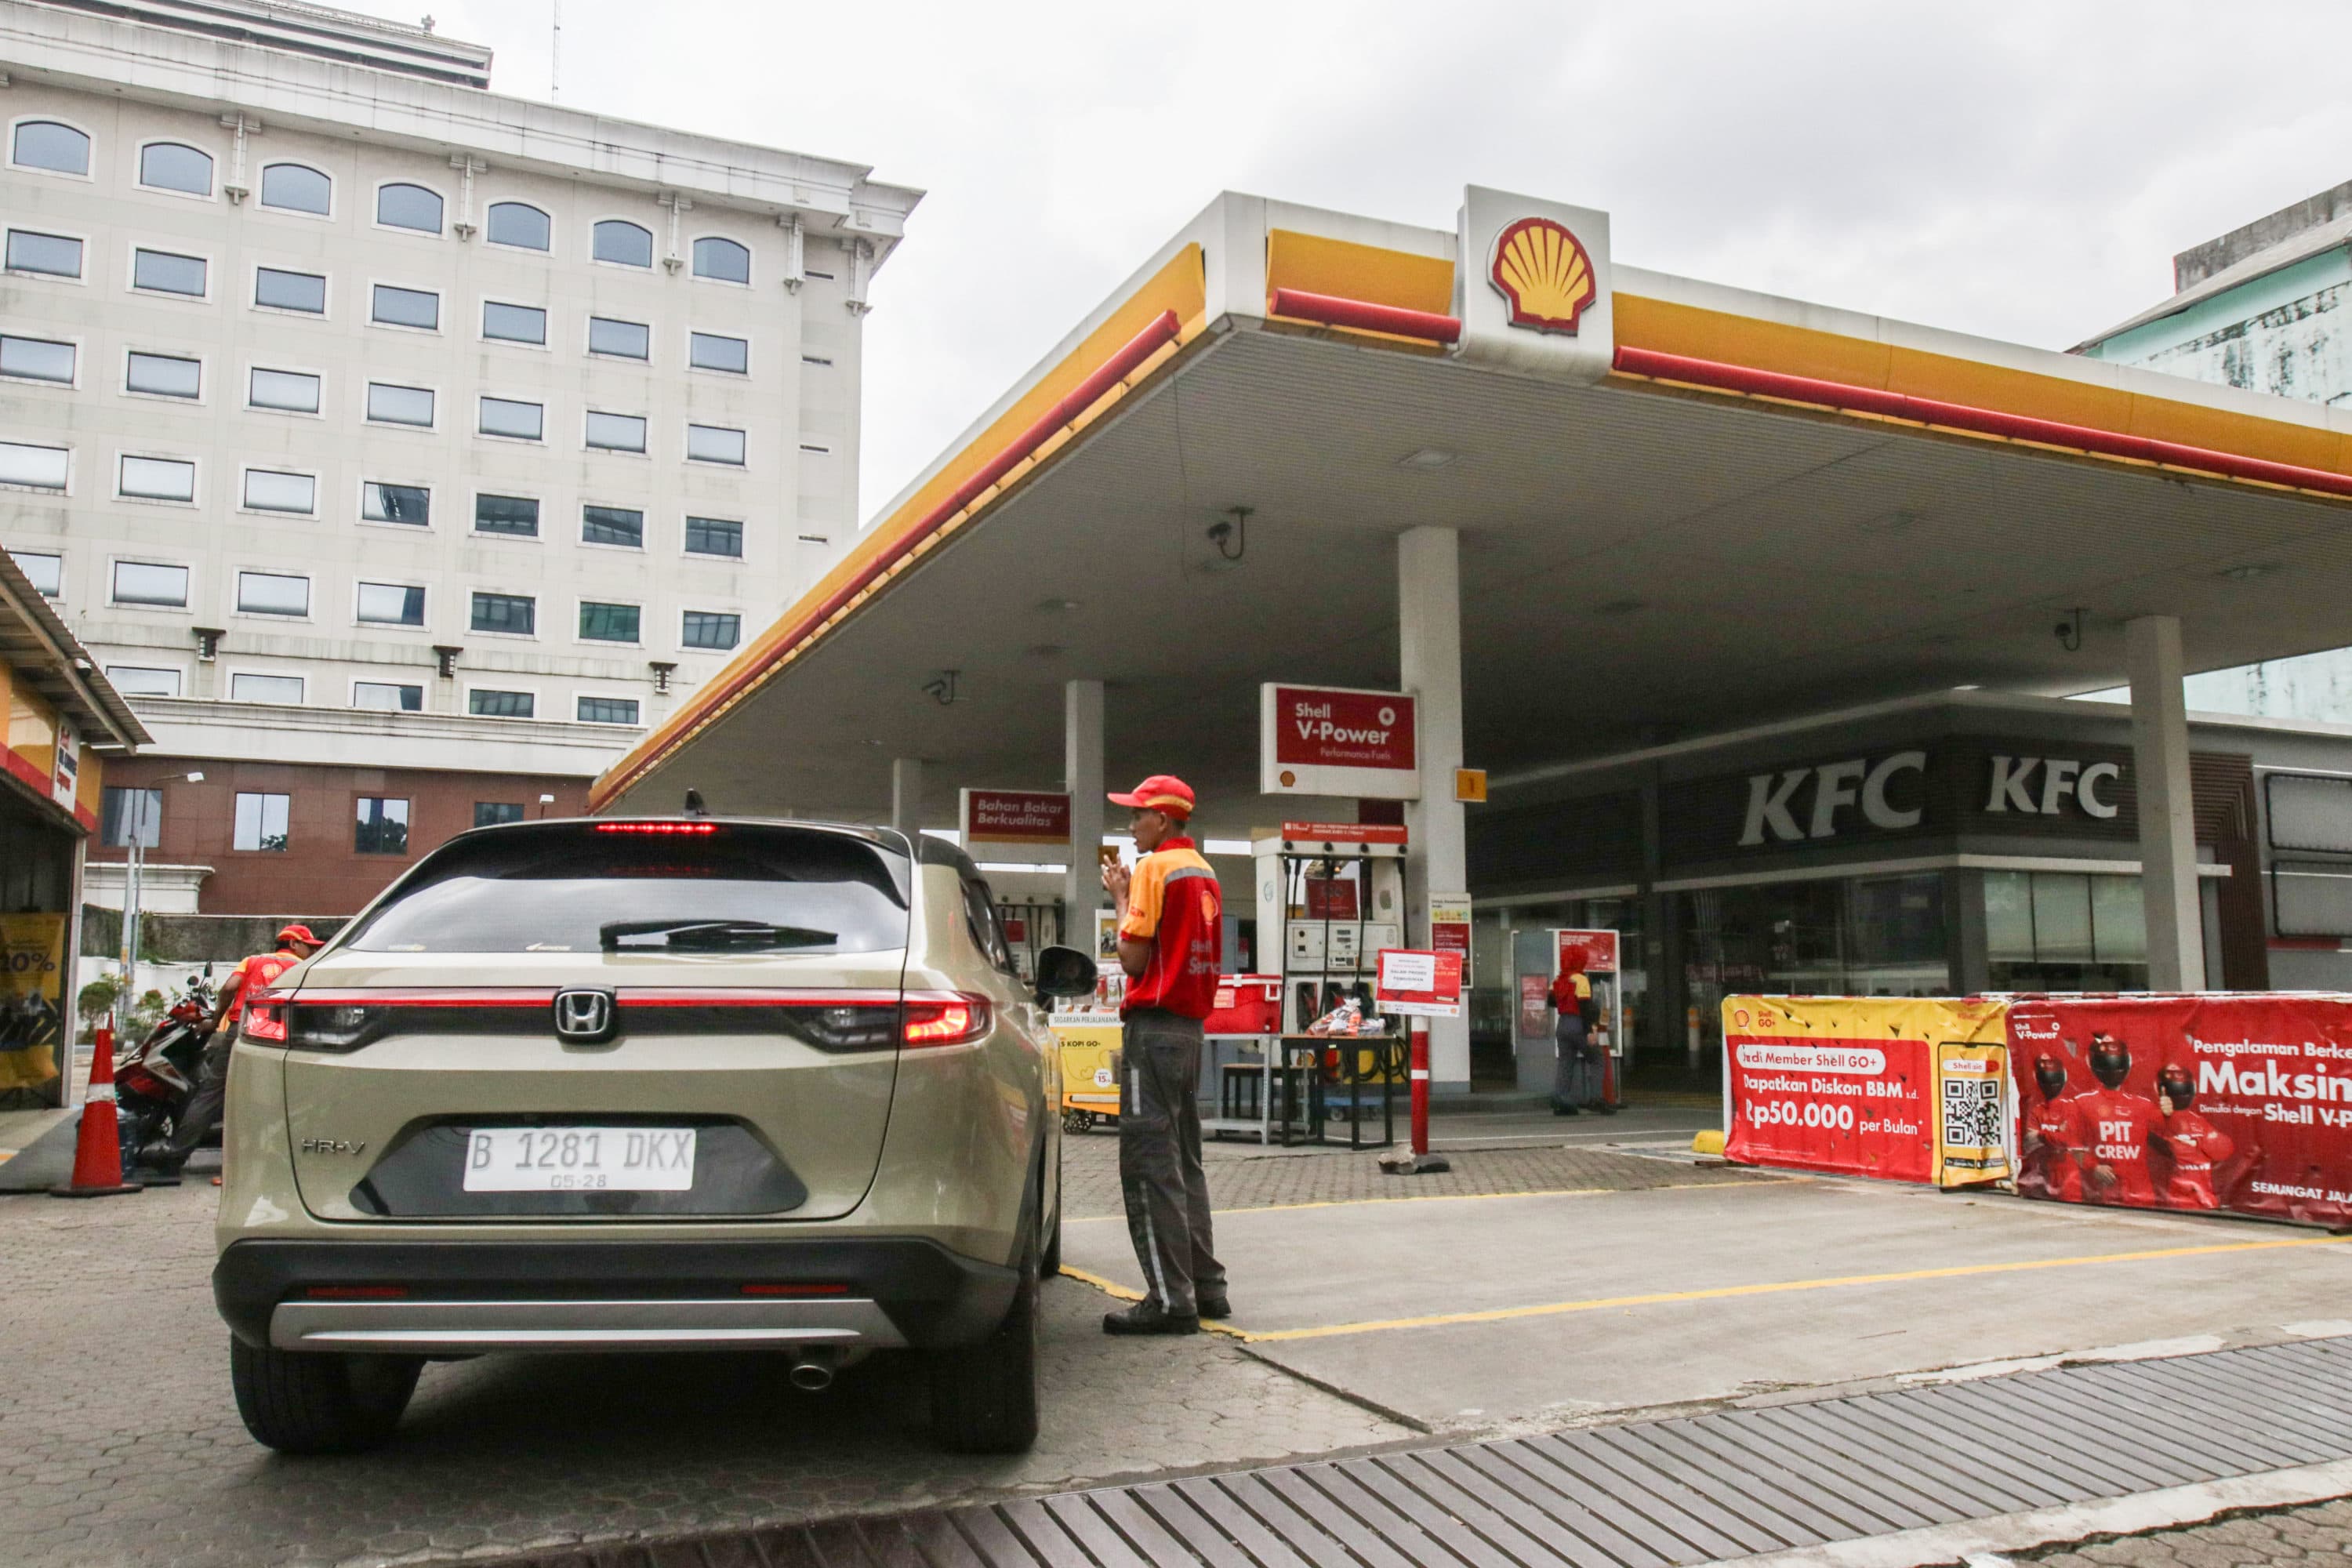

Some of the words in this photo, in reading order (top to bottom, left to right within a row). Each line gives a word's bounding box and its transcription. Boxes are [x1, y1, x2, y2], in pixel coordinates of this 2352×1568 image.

[1295, 702, 1330, 718] Shell
[1297, 720, 1390, 745] V-Power
[1320, 747, 1370, 760] Performance
[1372, 749, 1391, 760] Fuels
[1985, 755, 2119, 818] KFC
[978, 799, 1019, 813] Bahan
[1024, 801, 1063, 815] Bakar
[1737, 750, 1926, 846] KFC
[978, 813, 1051, 826] Berkualitas
[2016, 1030, 2058, 1040] V-Power
[2193, 1039, 2299, 1057] Pengalaman
[1765, 1053, 1813, 1066] Member
[1816, 1054, 1846, 1067] Shell
[1849, 1055, 1877, 1069] GO+
[1743, 1074, 1808, 1093] Dapatkan
[1812, 1078, 1862, 1096] Diskon
[1866, 1081, 1904, 1098] BBM
[1745, 1098, 1854, 1130] Rp50.000
[1859, 1120, 1881, 1134] per
[2264, 1102, 2314, 1125] Shell
[2099, 1121, 2133, 1142] PIT
[301, 1139, 366, 1153] HR-V
[472, 1134, 492, 1170] B
[515, 1132, 601, 1168] 1281
[623, 1132, 692, 1169] DKX
[2095, 1145, 2140, 1160] CREW
[2251, 1181, 2324, 1200] SEMANGAT
